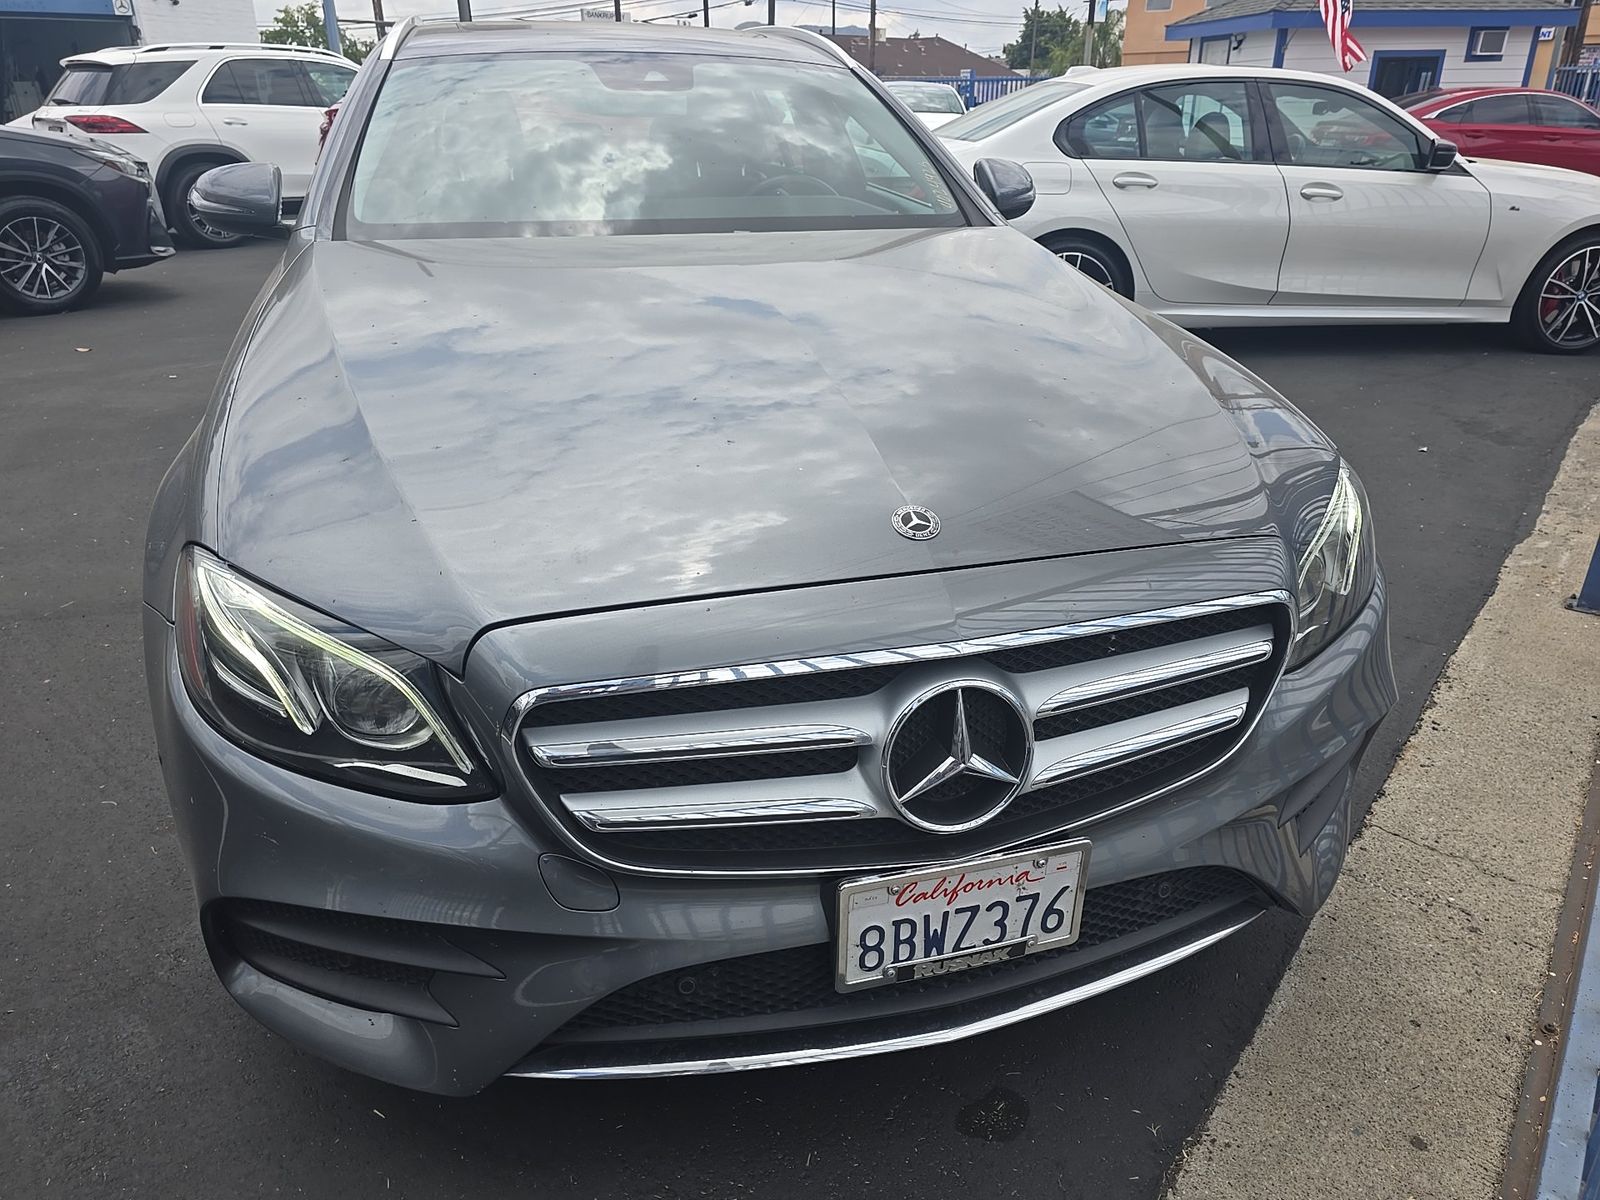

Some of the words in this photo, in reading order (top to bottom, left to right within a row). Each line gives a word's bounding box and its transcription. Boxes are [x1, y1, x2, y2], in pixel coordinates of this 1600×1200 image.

[586, 10, 626, 20] BANKRUPY
[895, 869, 1046, 907] California
[858, 885, 1071, 972] 8BWZ376
